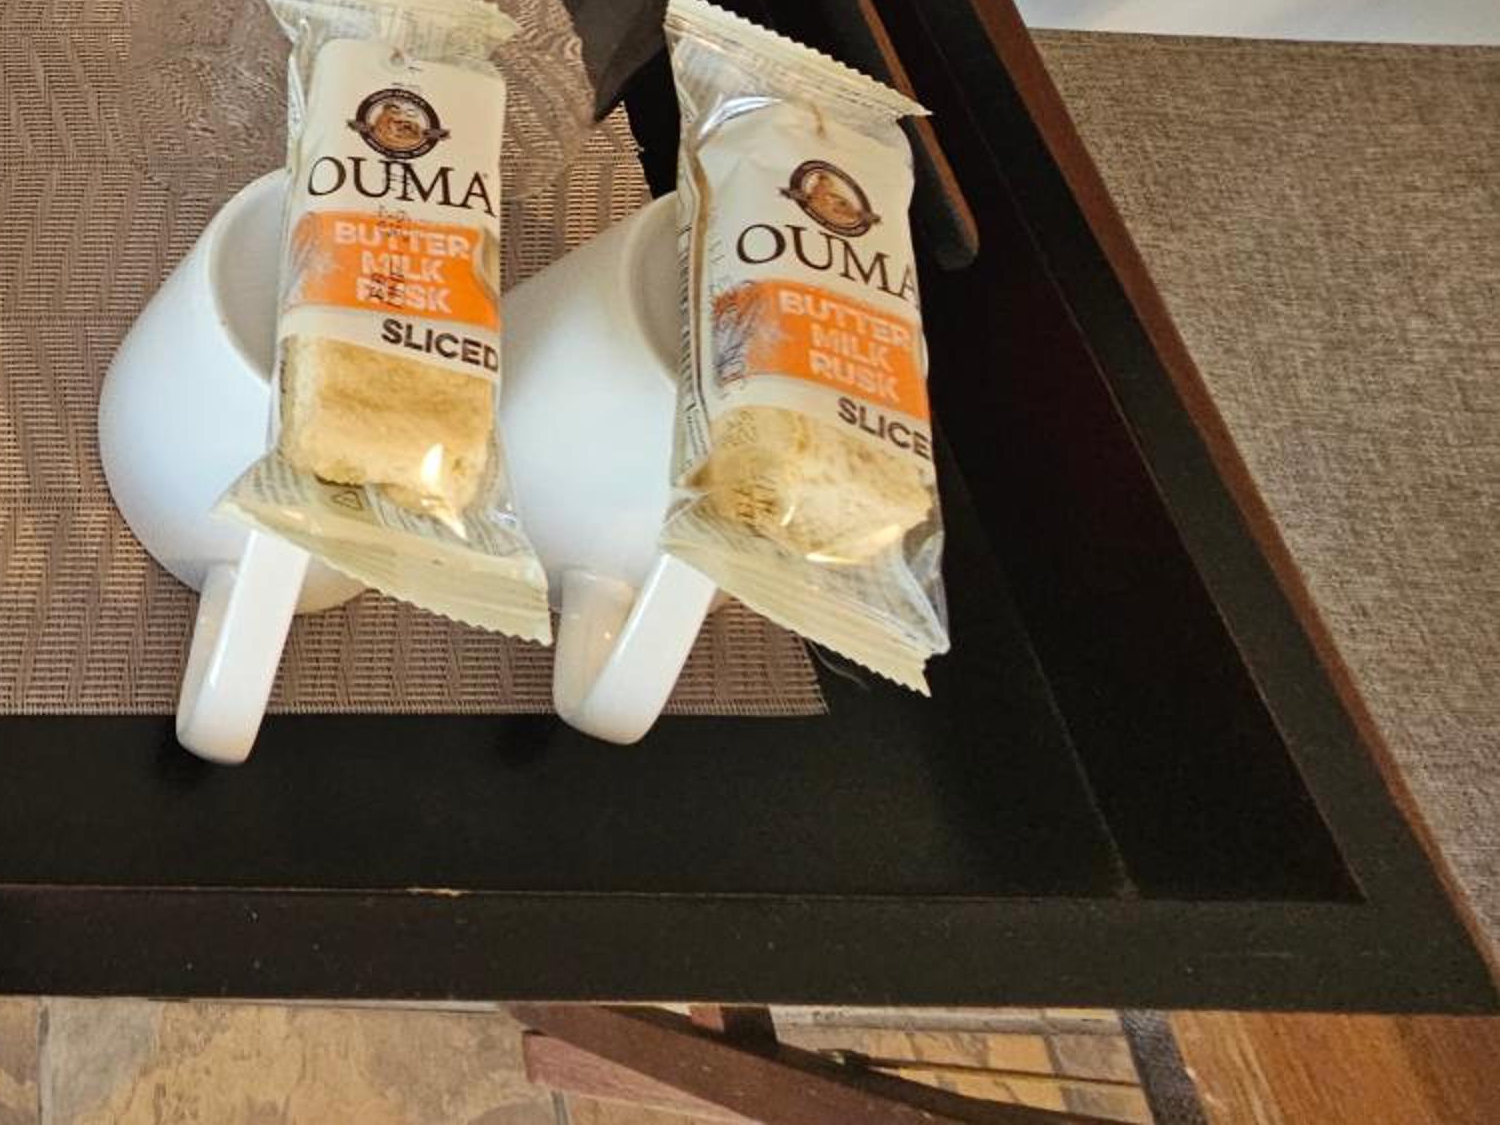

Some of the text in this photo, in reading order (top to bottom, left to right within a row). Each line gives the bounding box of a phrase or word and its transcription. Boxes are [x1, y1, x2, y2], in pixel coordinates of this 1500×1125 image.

[307, 155, 498, 218] OUMA
[333, 220, 470, 260] BUTTER
[360, 250, 446, 284] MILK
[736, 224, 918, 300] OUMA
[380, 317, 500, 373] SLICED
[778, 288, 911, 349] BUTTER
[808, 348, 900, 401] RUSK
[810, 322, 894, 373] MILK
[837, 396, 931, 461] SLICE
